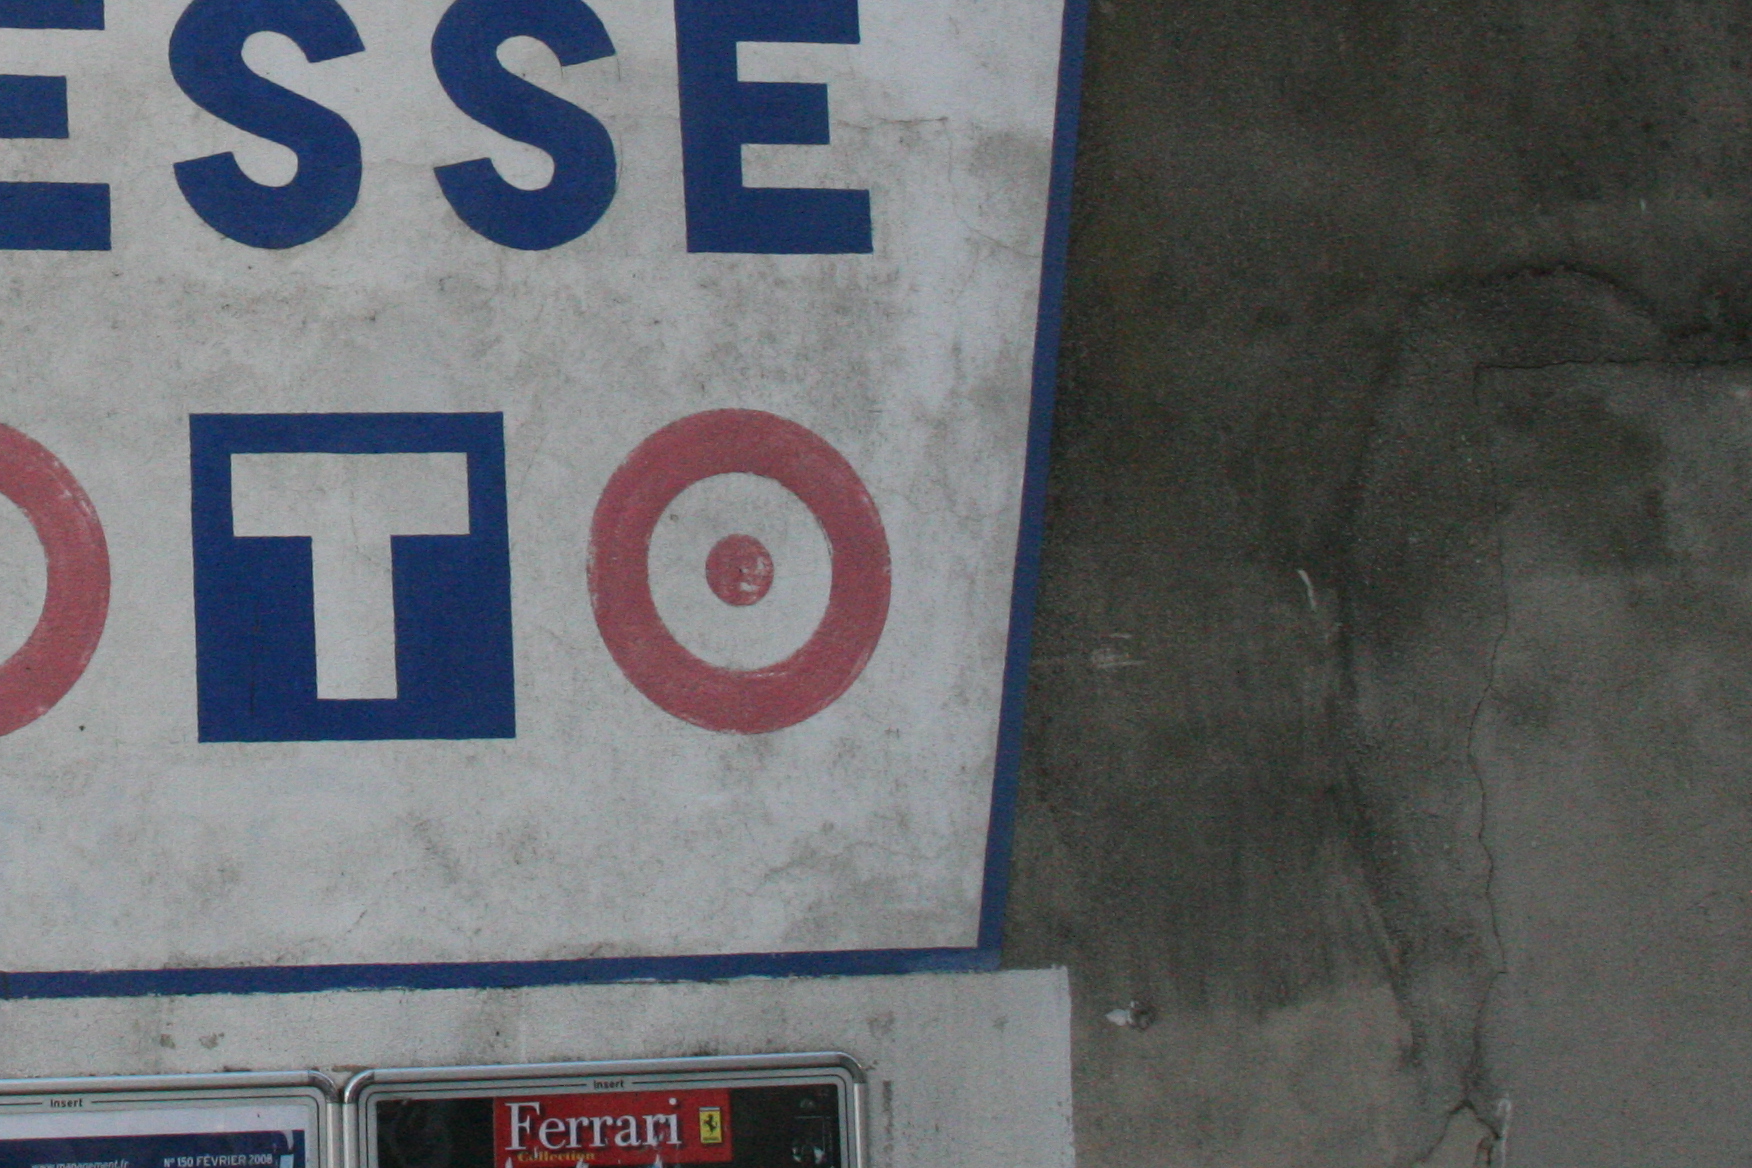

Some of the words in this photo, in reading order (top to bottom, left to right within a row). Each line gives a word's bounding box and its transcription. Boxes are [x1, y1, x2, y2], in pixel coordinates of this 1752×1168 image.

[592, 1079, 626, 1090] Insert
[49, 1098, 84, 1108] Insert
[503, 1096, 685, 1152] Ferrari
[177, 1155, 194, 1168] 150
[196, 1152, 247, 1167] FÉVRIER
